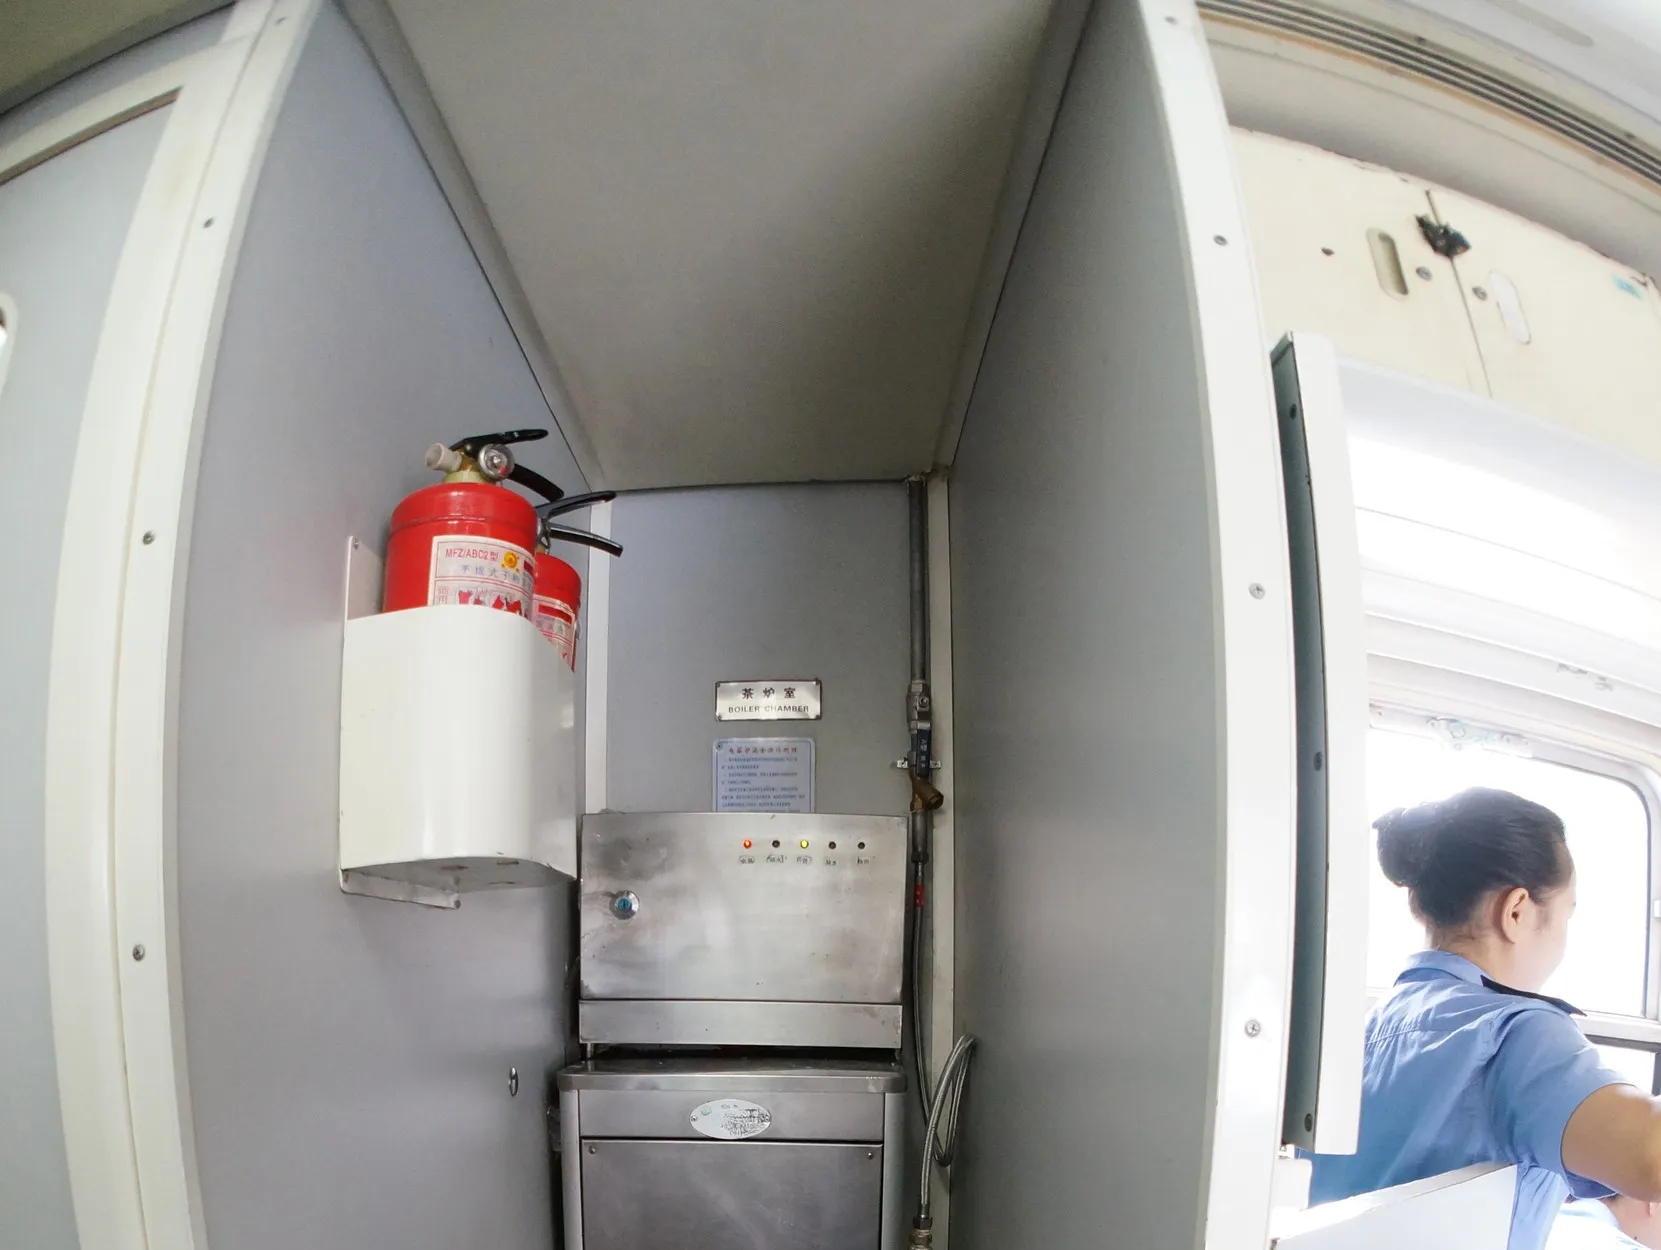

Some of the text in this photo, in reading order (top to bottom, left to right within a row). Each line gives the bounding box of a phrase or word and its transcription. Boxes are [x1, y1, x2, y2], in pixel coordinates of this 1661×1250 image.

[741, 686, 796, 700] 茶炉室
[728, 704, 809, 714] BOILER CHAMBER
